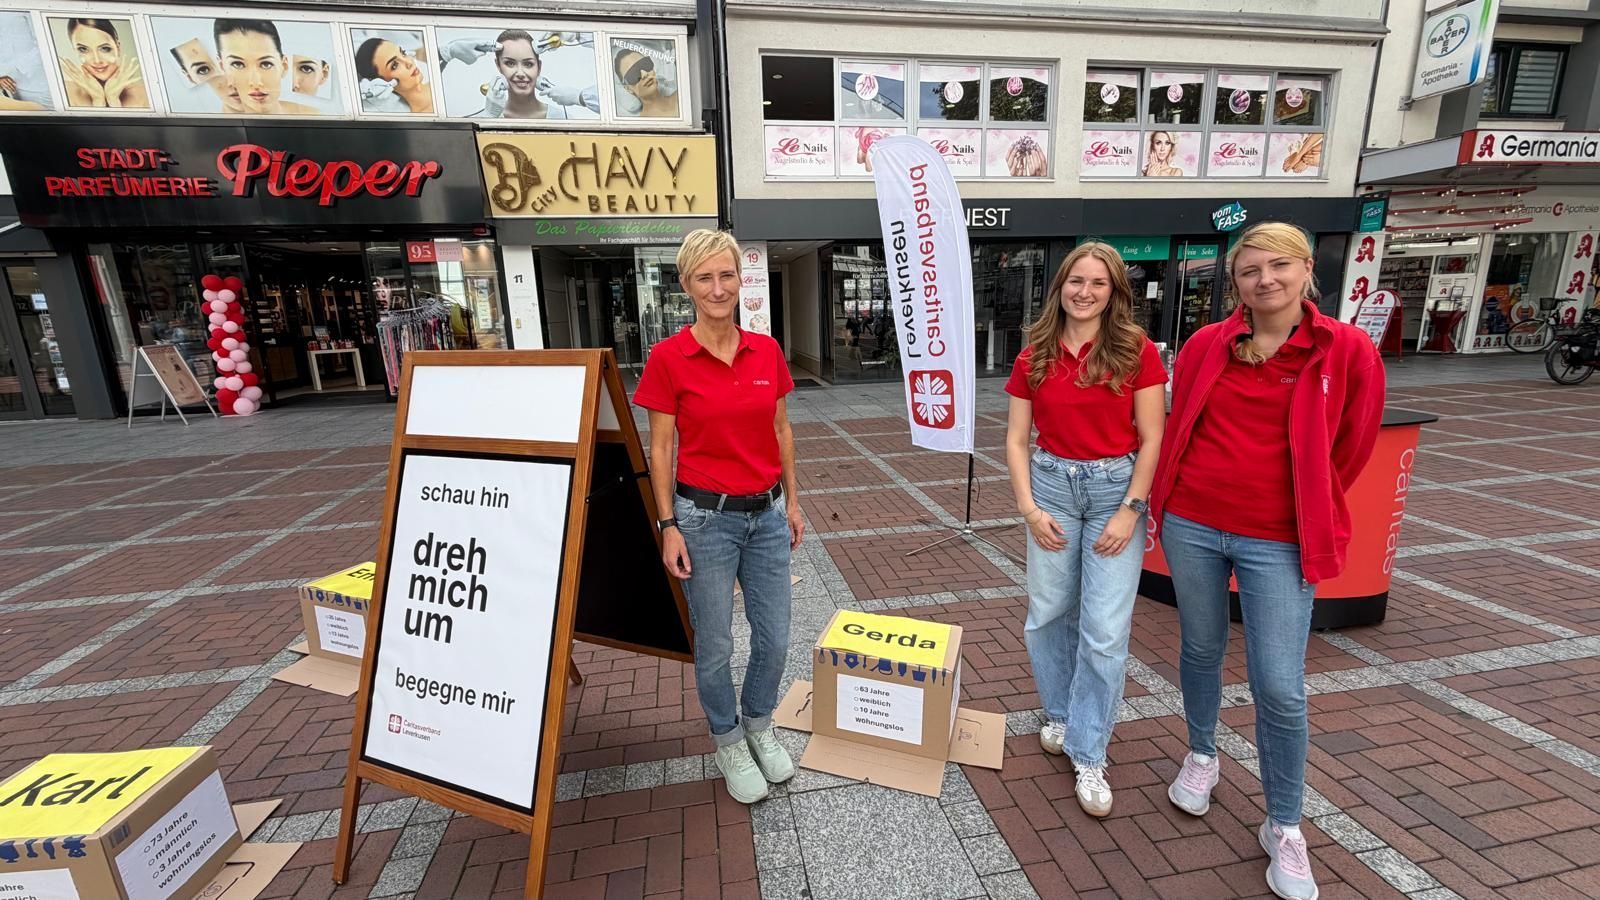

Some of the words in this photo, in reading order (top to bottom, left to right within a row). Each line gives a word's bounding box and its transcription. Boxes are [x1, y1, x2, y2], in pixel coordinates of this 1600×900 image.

[1430, 27, 1466, 46] BAYER
[1441, 19, 1454, 54] BAYER
[1420, 63, 1458, 79] Germania
[1422, 70, 1459, 87] Apotheke
[803, 144, 828, 152] Nails
[952, 145, 975, 153] Nails
[1111, 146, 1133, 154] Nails
[1239, 147, 1258, 156] Nails
[1501, 135, 1598, 158] Germania
[77, 147, 169, 170] STADT-
[217, 144, 441, 206] Pieper
[45, 173, 212, 197] PARFÜMERIE
[531, 186, 558, 213] City
[588, 195, 696, 213] BEAUTY
[1212, 206, 1232, 221] vom
[1565, 205, 1599, 216] Apotheke
[535, 220, 568, 235] Das
[575, 221, 682, 238] Papierlädchen
[1217, 209, 1248, 231] FASS
[410, 244, 432, 259] 95
[746, 252, 759, 264] 19
[1123, 246, 1138, 255] Essig
[1201, 247, 1214, 255] Sekt
[420, 483, 475, 506] schau
[480, 486, 510, 509] hin
[1382, 448, 1415, 575] caritas
[413, 532, 488, 575] dreh
[408, 569, 489, 613] mich
[404, 608, 454, 644] um
[842, 623, 936, 650] Gerda
[395, 667, 477, 705] begegne
[482, 691, 516, 716] mir
[860, 686, 869, 694] 63
[870, 687, 890, 697] Jahre
[860, 696, 891, 708] weiblich
[860, 706, 869, 714] 10
[869, 707, 889, 718] Jahre
[403, 720, 441, 736] Caritasverband
[855, 715, 904, 732] wohnungslos
[402, 728, 431, 742] Leverkusen
[0, 766, 152, 808] Karl
[150, 833, 164, 848] 73
[164, 811, 188, 836] Jahre
[155, 819, 198, 860] männlich
[158, 832, 217, 889] wohnungslos
[159, 863, 167, 873] 3
[167, 840, 192, 866] Jahre
[0, 884, 24, 892] ahre
